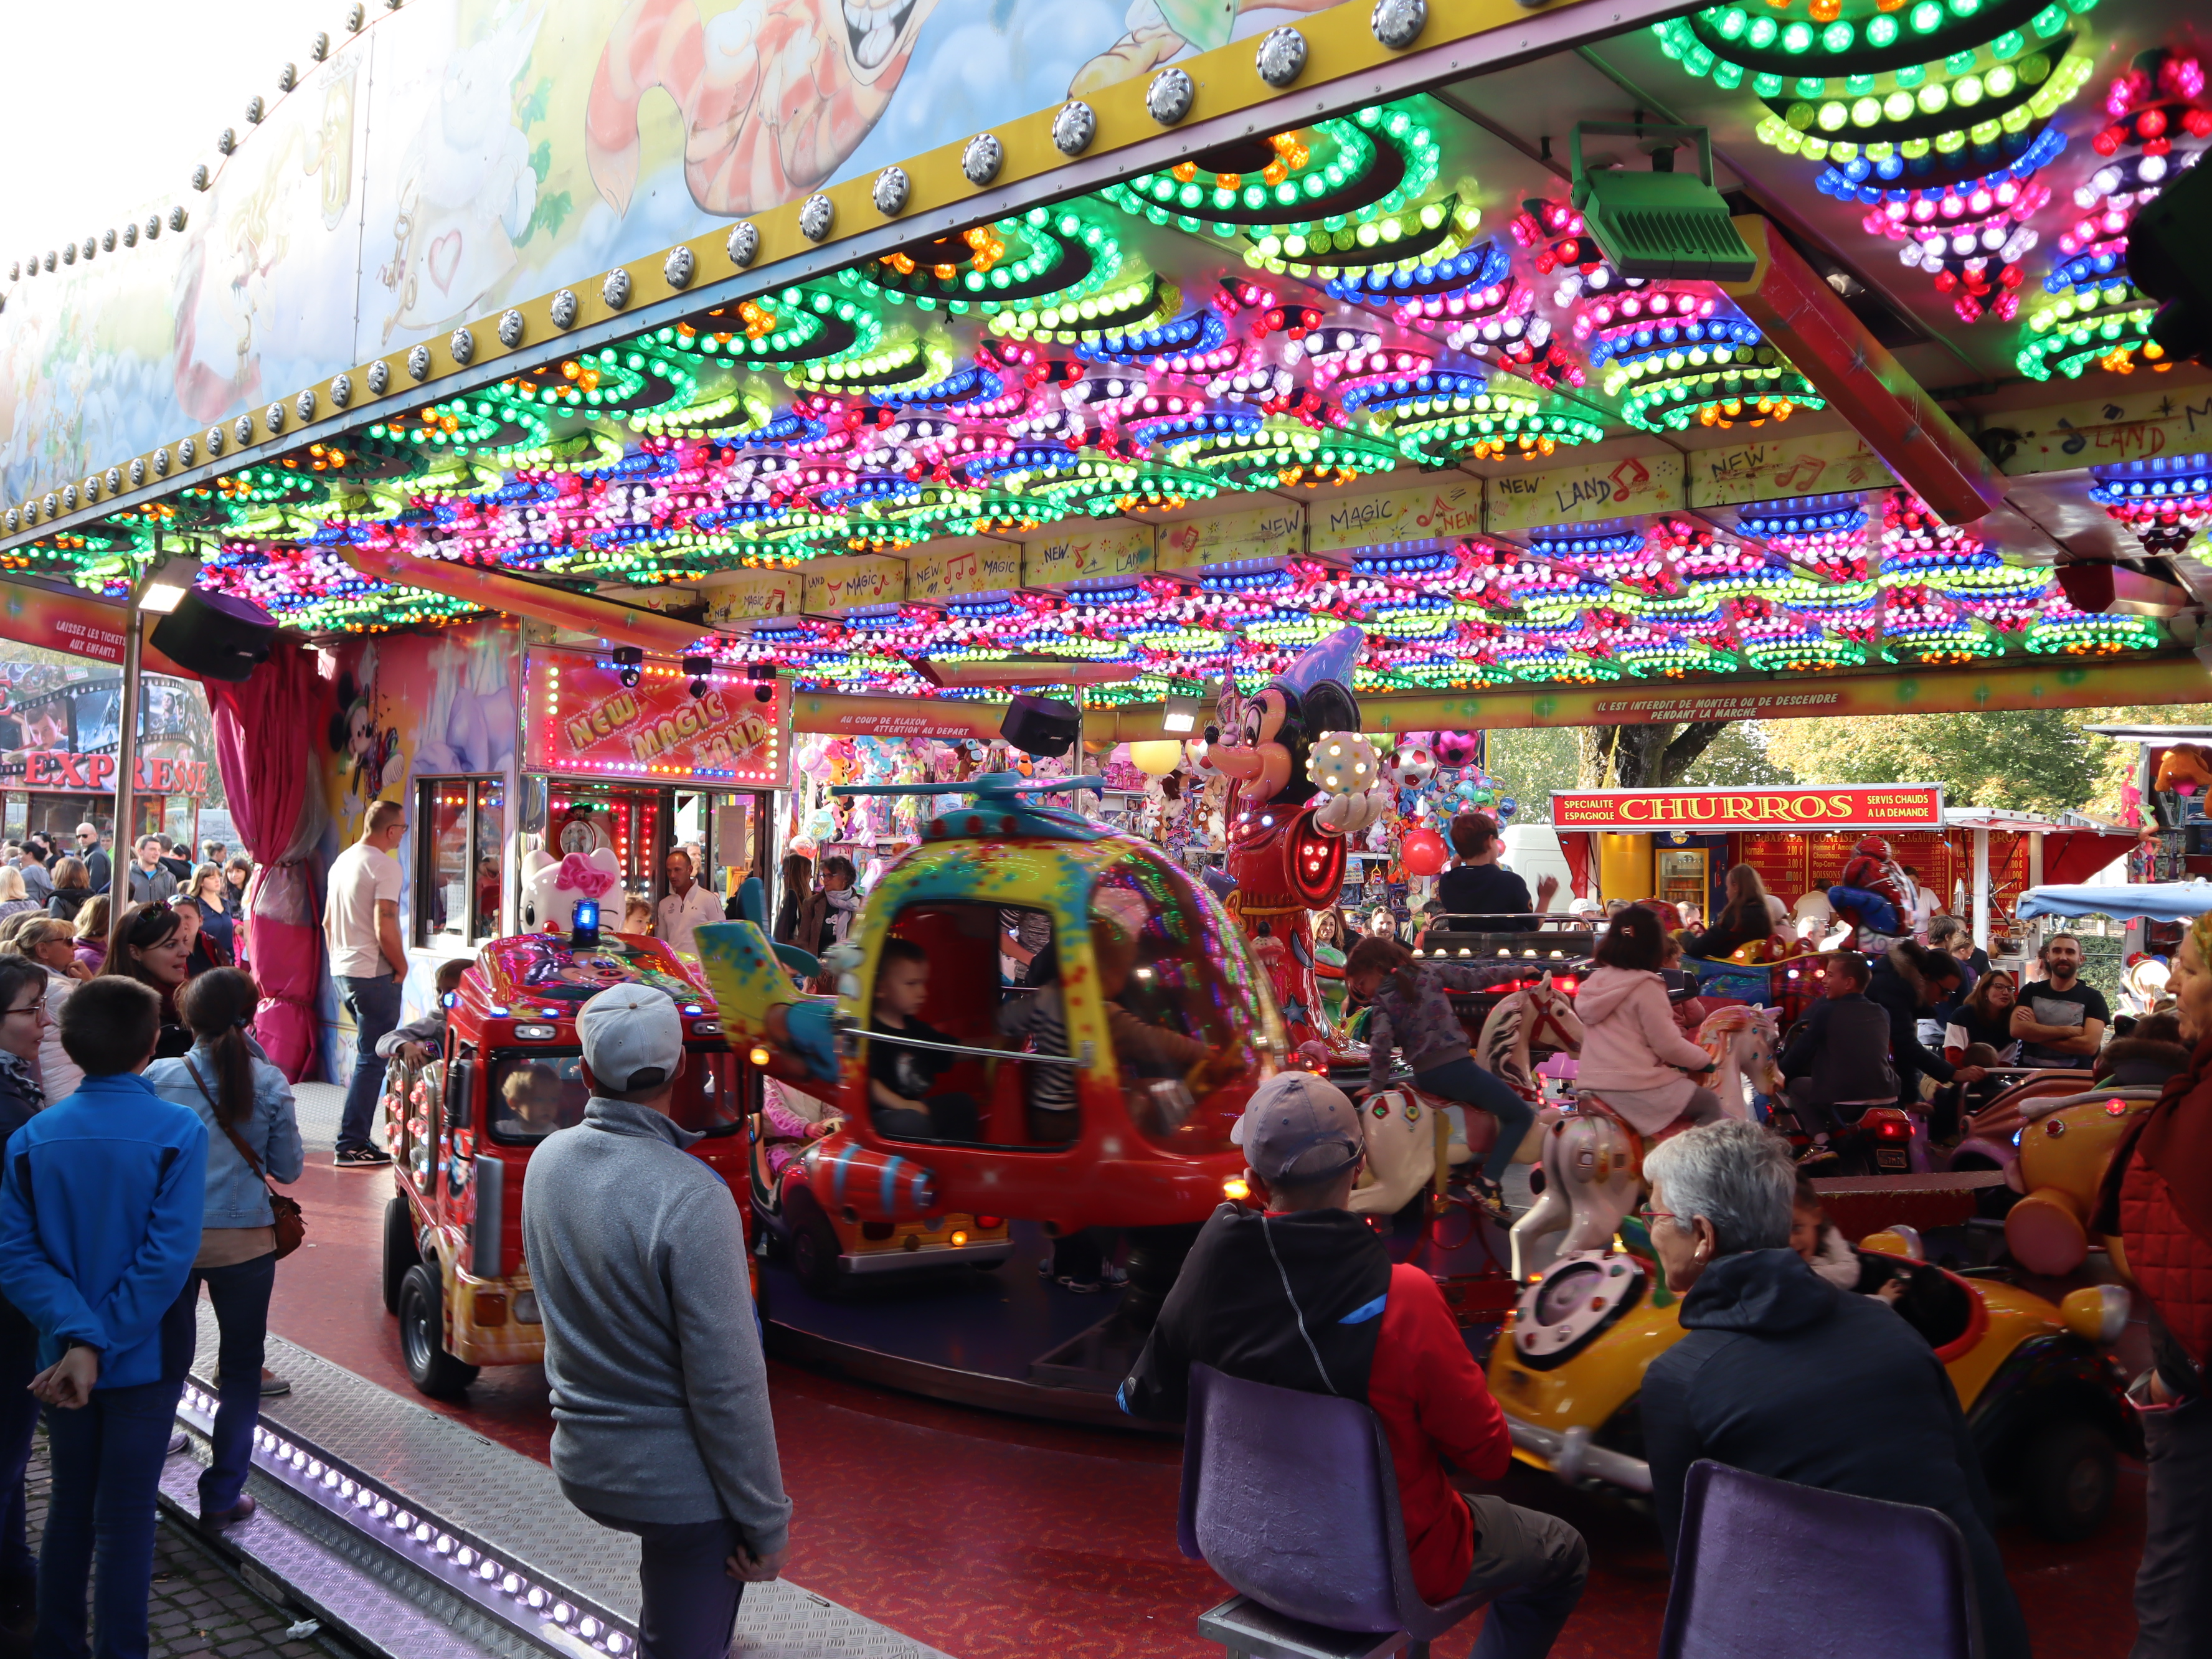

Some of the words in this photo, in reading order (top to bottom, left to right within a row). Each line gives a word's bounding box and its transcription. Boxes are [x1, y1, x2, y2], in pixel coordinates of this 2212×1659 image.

[2095, 425, 2165, 459] LAND
[1500, 477, 1539, 494] NEW
[1556, 477, 1611, 512] LAND
[1330, 499, 1392, 532] MAGIC
[1443, 504, 1478, 531] NEW
[1260, 510, 1299, 542] NEW
[1044, 544, 1069, 562] NEW
[917, 562, 940, 585] NEW
[983, 561, 1015, 576] MAGIC
[808, 576, 825, 588] LAND
[846, 569, 877, 596] MAGIC
[744, 592, 764, 608] MAGIC
[715, 604, 730, 618] NEW
[56, 620, 86, 636] LAISSEZ
[87, 628, 99, 640] LES
[101, 631, 126, 646] TICKETS
[69, 638, 85, 651] AUX
[86, 642, 115, 658] ENFANTS
[1597, 702, 1607, 711] IL
[1610, 701, 1627, 711] EST
[1630, 700, 1675, 710] INTERDIT
[1680, 699, 1692, 709] DE
[1695, 697, 1736, 708] MONTER
[1741, 697, 1754, 707] OU
[1758, 696, 1771, 706] DE
[1775, 694, 1838, 706] DESCENDRE
[568, 692, 636, 748] NEW
[855, 716, 876, 725] COUP
[894, 717, 927, 726] KLAXON
[1650, 709, 1696, 720] PENDANT
[1699, 709, 1711, 719] LA
[1714, 707, 1757, 717] MARCHE
[634, 693, 724, 762] MAGIC
[873, 725, 919, 734] ATTENTION
[936, 727, 969, 735] DEPART
[698, 717, 765, 767] LAND
[1564, 800, 1614, 809] SPECIALITE
[1867, 795, 1894, 805] SERVIS
[1895, 794, 1929, 803] CHAUDS
[1564, 811, 1615, 820] ESPAGNOLE
[1619, 795, 1853, 821] CHURROS
[1868, 808, 1874, 817] A
[1875, 808, 1886, 817] LA
[1887, 808, 1929, 816] DEMANDE
[1744, 834, 1803, 843] BARBAPAPA
[1745, 846, 1764, 856] Normale
[1787, 846, 1797, 856] 2.00
[1800, 846, 1803, 856] €
[1788, 859, 1798, 869] 3.00
[1800, 858, 1803, 868] €
[1957, 859, 1965, 868] Les
[1812, 871, 1841, 879] BOISSONS
